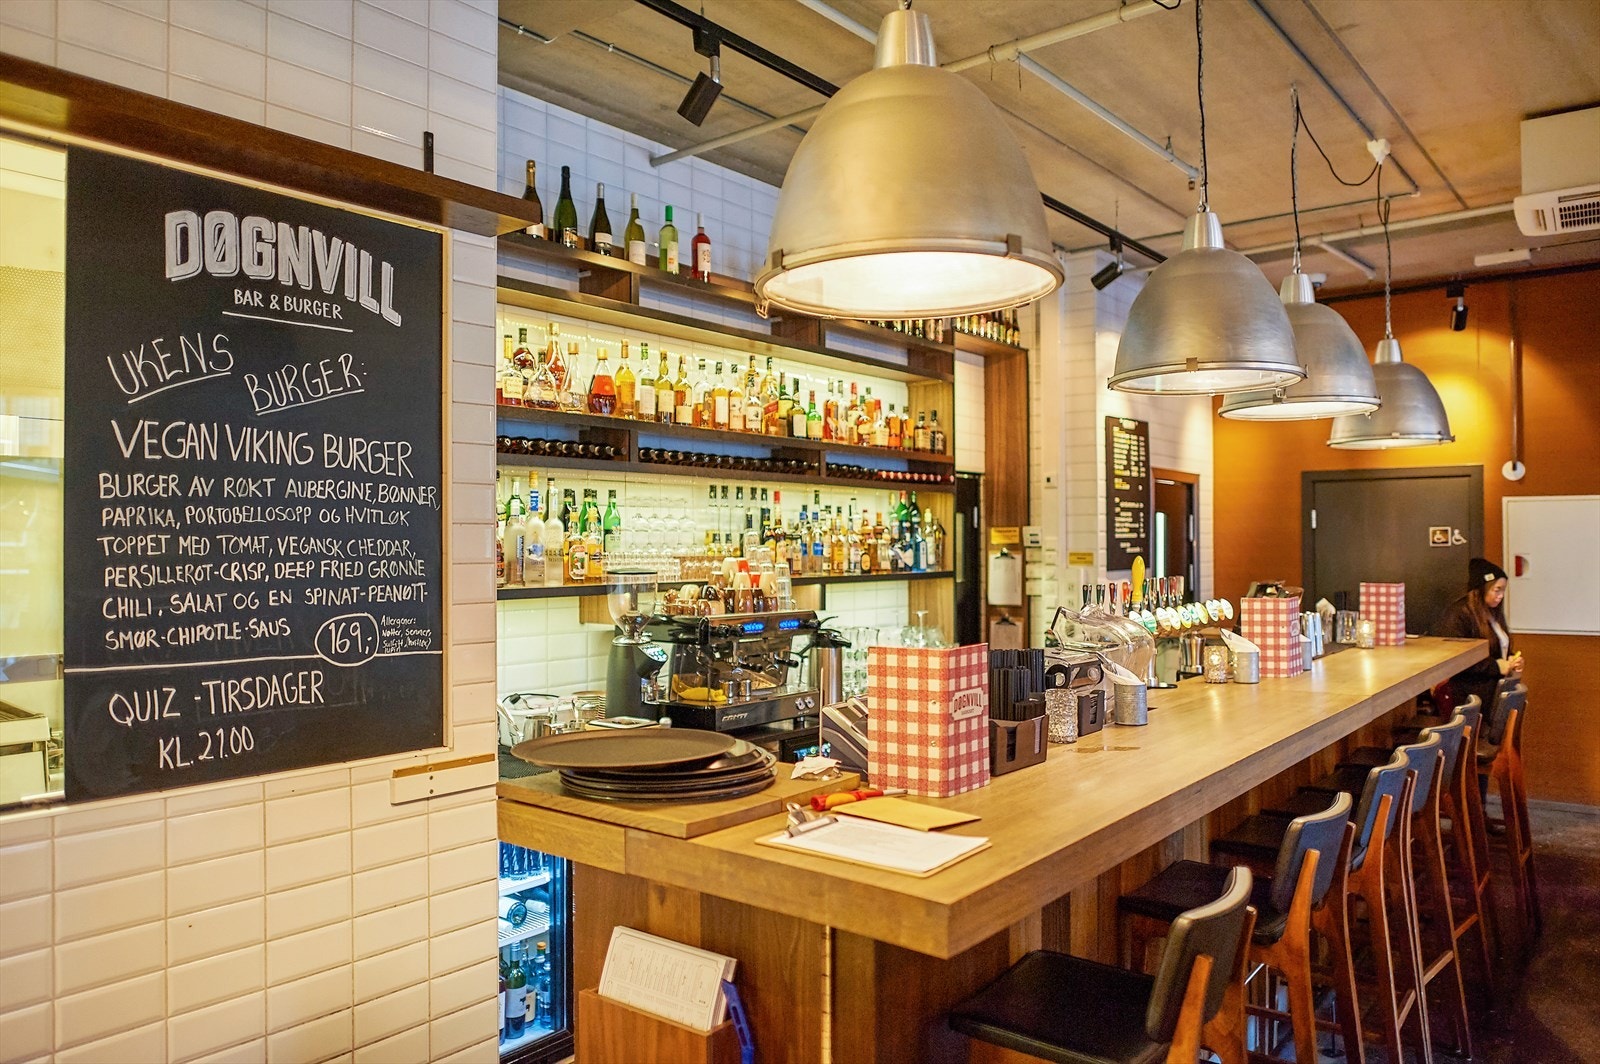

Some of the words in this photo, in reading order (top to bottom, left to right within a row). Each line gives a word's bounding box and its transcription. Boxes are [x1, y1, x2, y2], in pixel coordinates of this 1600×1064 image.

[164, 209, 402, 328] DØGNVILL
[233, 289, 264, 308] BAR
[270, 295, 281, 310] &
[284, 297, 343, 320] BURGER
[107, 333, 234, 396] UKENS
[244, 353, 368, 412] BURGER:
[111, 419, 217, 461] VEGAN
[225, 424, 314, 465] VIKING
[323, 434, 414, 478] BURGER
[98, 474, 181, 499] BURGER
[189, 478, 215, 497] AV
[224, 478, 276, 498] RØKT
[285, 478, 377, 503] AUBERGINE,
[378, 484, 440, 511] BØNNER,
[101, 507, 181, 530] PAPRIKA,
[185, 505, 313, 525] PORTOBELLOSOPP
[319, 509, 341, 524] OG
[345, 505, 410, 527] HVITLØK
[97, 535, 171, 556] TOPPET
[178, 536, 210, 556] MED
[216, 535, 274, 558] TOMAT,
[276, 537, 346, 558] VEGANSK
[347, 537, 417, 561] CHEDDAR,
[104, 561, 270, 588] PERSILLEROT-CRISP,
[274, 560, 315, 580] DEEP
[320, 559, 364, 580] FRIED
[367, 558, 426, 579] GRØNNE
[102, 596, 163, 620] CHILI,
[168, 592, 226, 615] SALAT
[232, 592, 260, 610] OG
[268, 590, 293, 607] EN
[108, 687, 182, 727] QUIZ
